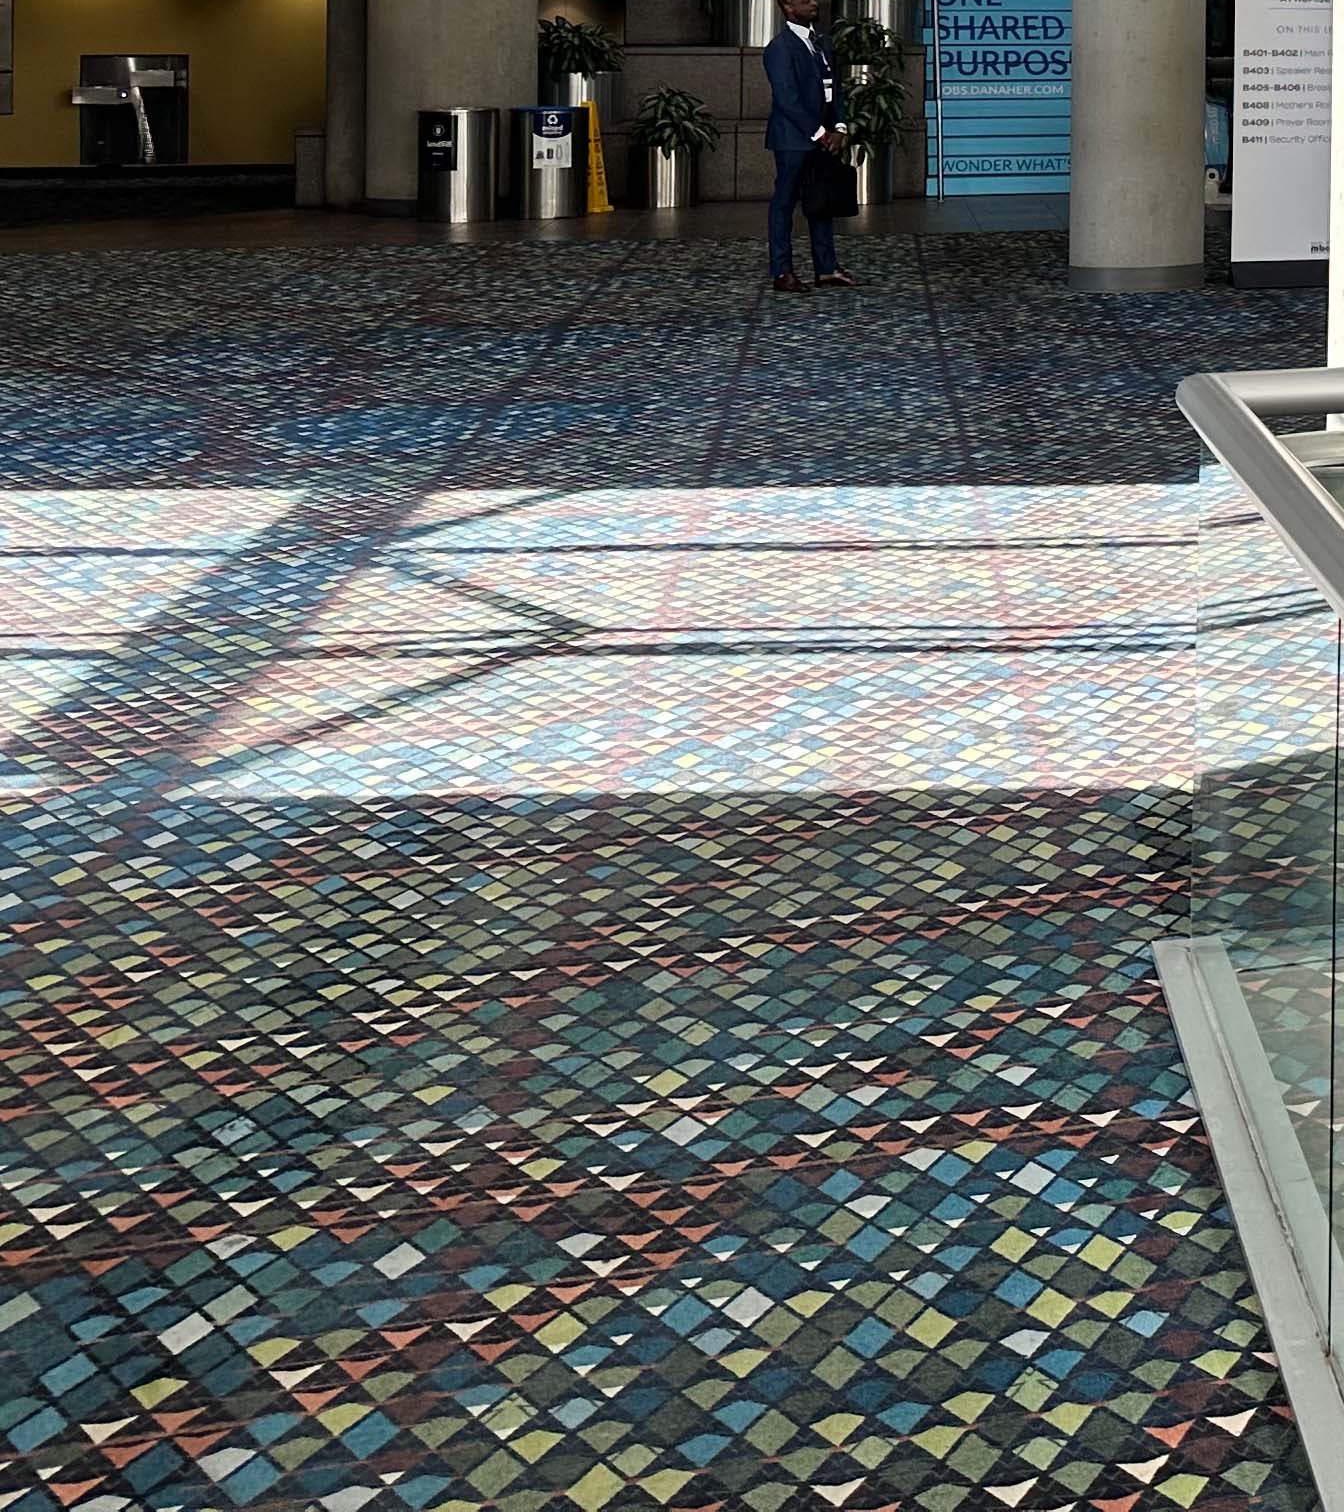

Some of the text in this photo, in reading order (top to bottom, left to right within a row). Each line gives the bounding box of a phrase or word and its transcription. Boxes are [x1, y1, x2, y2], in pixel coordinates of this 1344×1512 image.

[938, 15, 1065, 41] SHARED
[939, 50, 1072, 76] PURPOS
[942, 85, 1064, 95] OBS.DANAHER.COM
[943, 159, 1013, 172] WONDER
